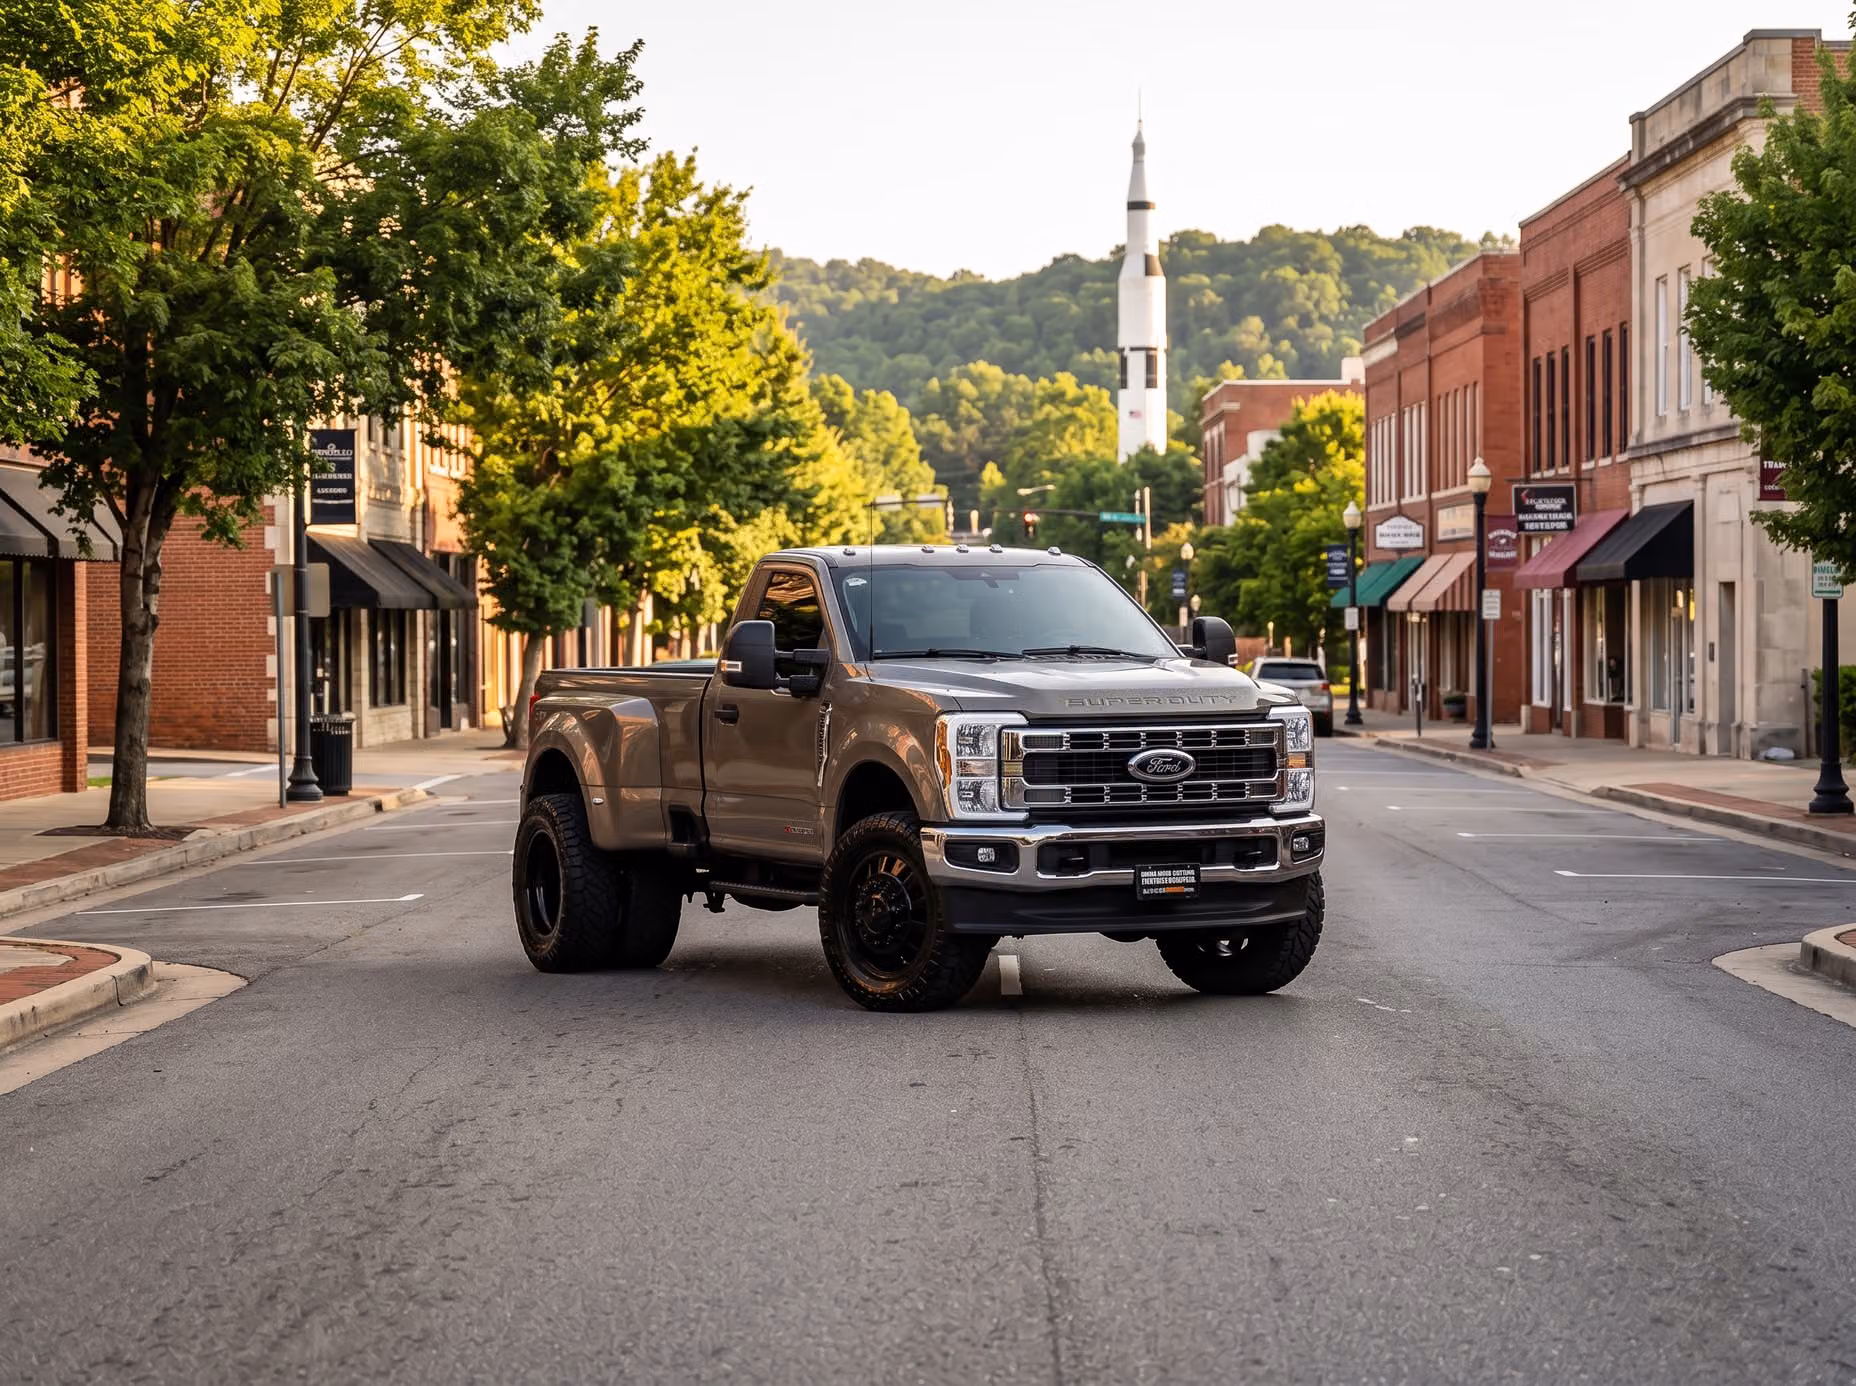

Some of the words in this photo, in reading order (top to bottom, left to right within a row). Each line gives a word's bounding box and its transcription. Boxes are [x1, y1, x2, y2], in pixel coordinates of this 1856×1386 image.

[1065, 696, 1163, 708] SUPER
[1166, 694, 1237, 705] DUTY
[1146, 757, 1181, 773] Ford
